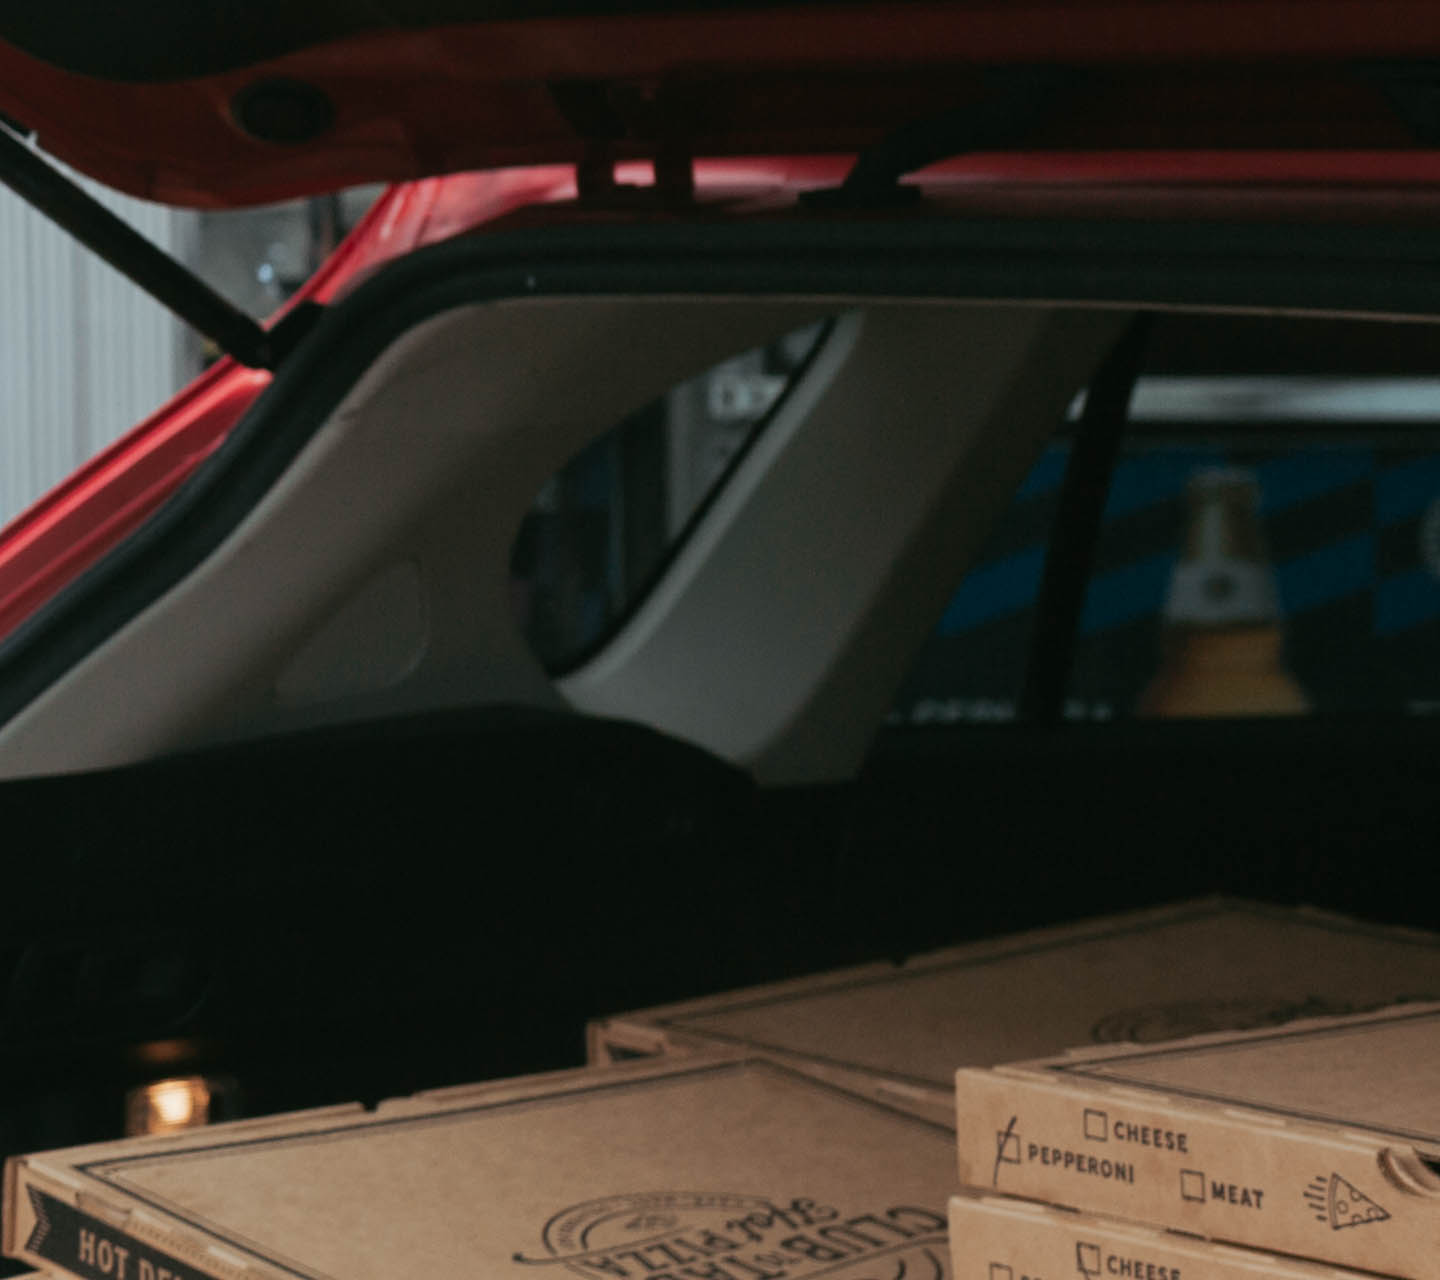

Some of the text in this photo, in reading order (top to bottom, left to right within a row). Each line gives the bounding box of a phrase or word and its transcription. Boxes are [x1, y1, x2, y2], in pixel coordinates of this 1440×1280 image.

[1113, 1121, 1189, 1153] CHEESE
[1027, 1143, 1265, 1209] PEPPERONI MEAT
[79, 1228, 129, 1280] HOT
